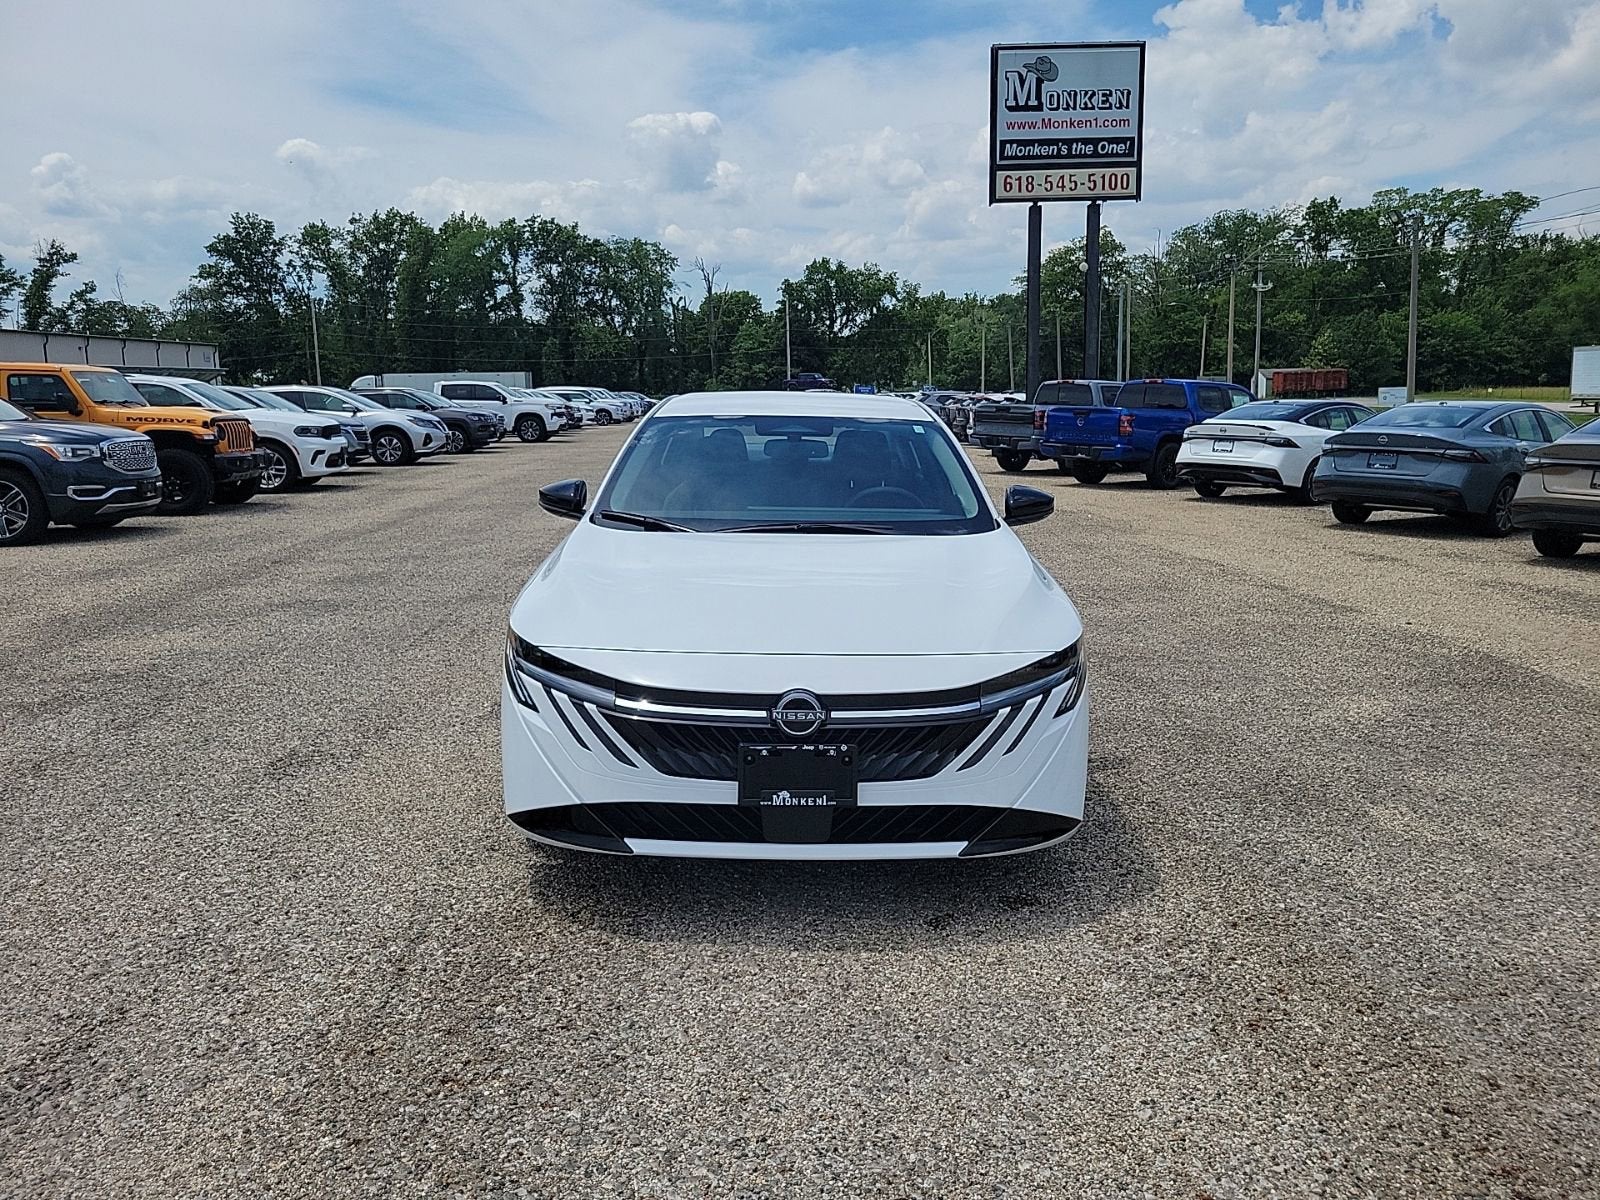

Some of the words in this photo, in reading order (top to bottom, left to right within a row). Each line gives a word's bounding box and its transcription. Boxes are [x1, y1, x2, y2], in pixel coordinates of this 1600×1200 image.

[1005, 71, 1131, 112] MONKEN
[1006, 117, 1130, 130] www.Monken1.com
[1004, 143, 1068, 157] Monken's
[1071, 142, 1093, 155] the
[1098, 141, 1130, 154] One!
[1003, 172, 1131, 193] 618-545-5100
[126, 416, 197, 424] MOJAVE
[772, 712, 825, 720] NISSAN
